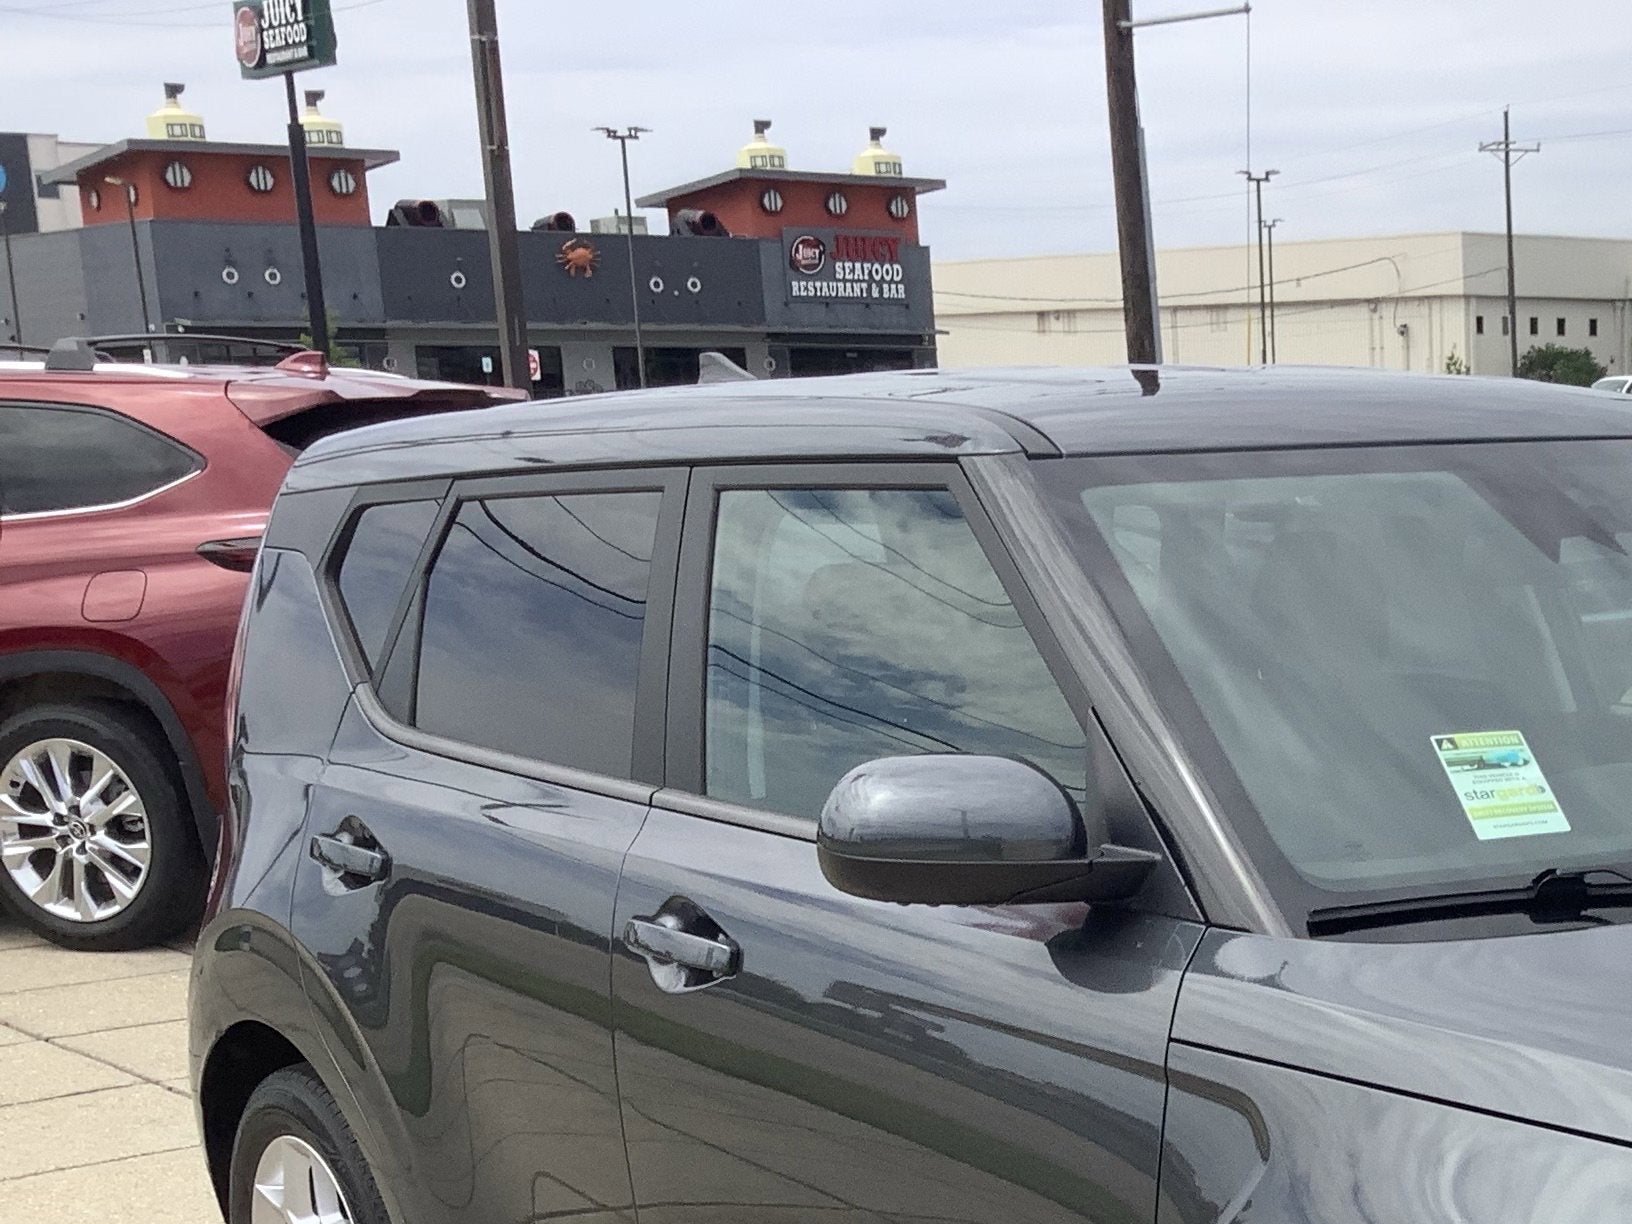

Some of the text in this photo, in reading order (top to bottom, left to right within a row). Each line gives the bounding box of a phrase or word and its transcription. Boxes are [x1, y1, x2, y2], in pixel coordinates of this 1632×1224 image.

[261, 0, 303, 28] JUICY
[262, 22, 307, 49] SEAFOOD
[830, 234, 899, 262] JUICY
[835, 261, 903, 281] SEAFOOD
[791, 281, 906, 299] RESTAURANT & BAR
